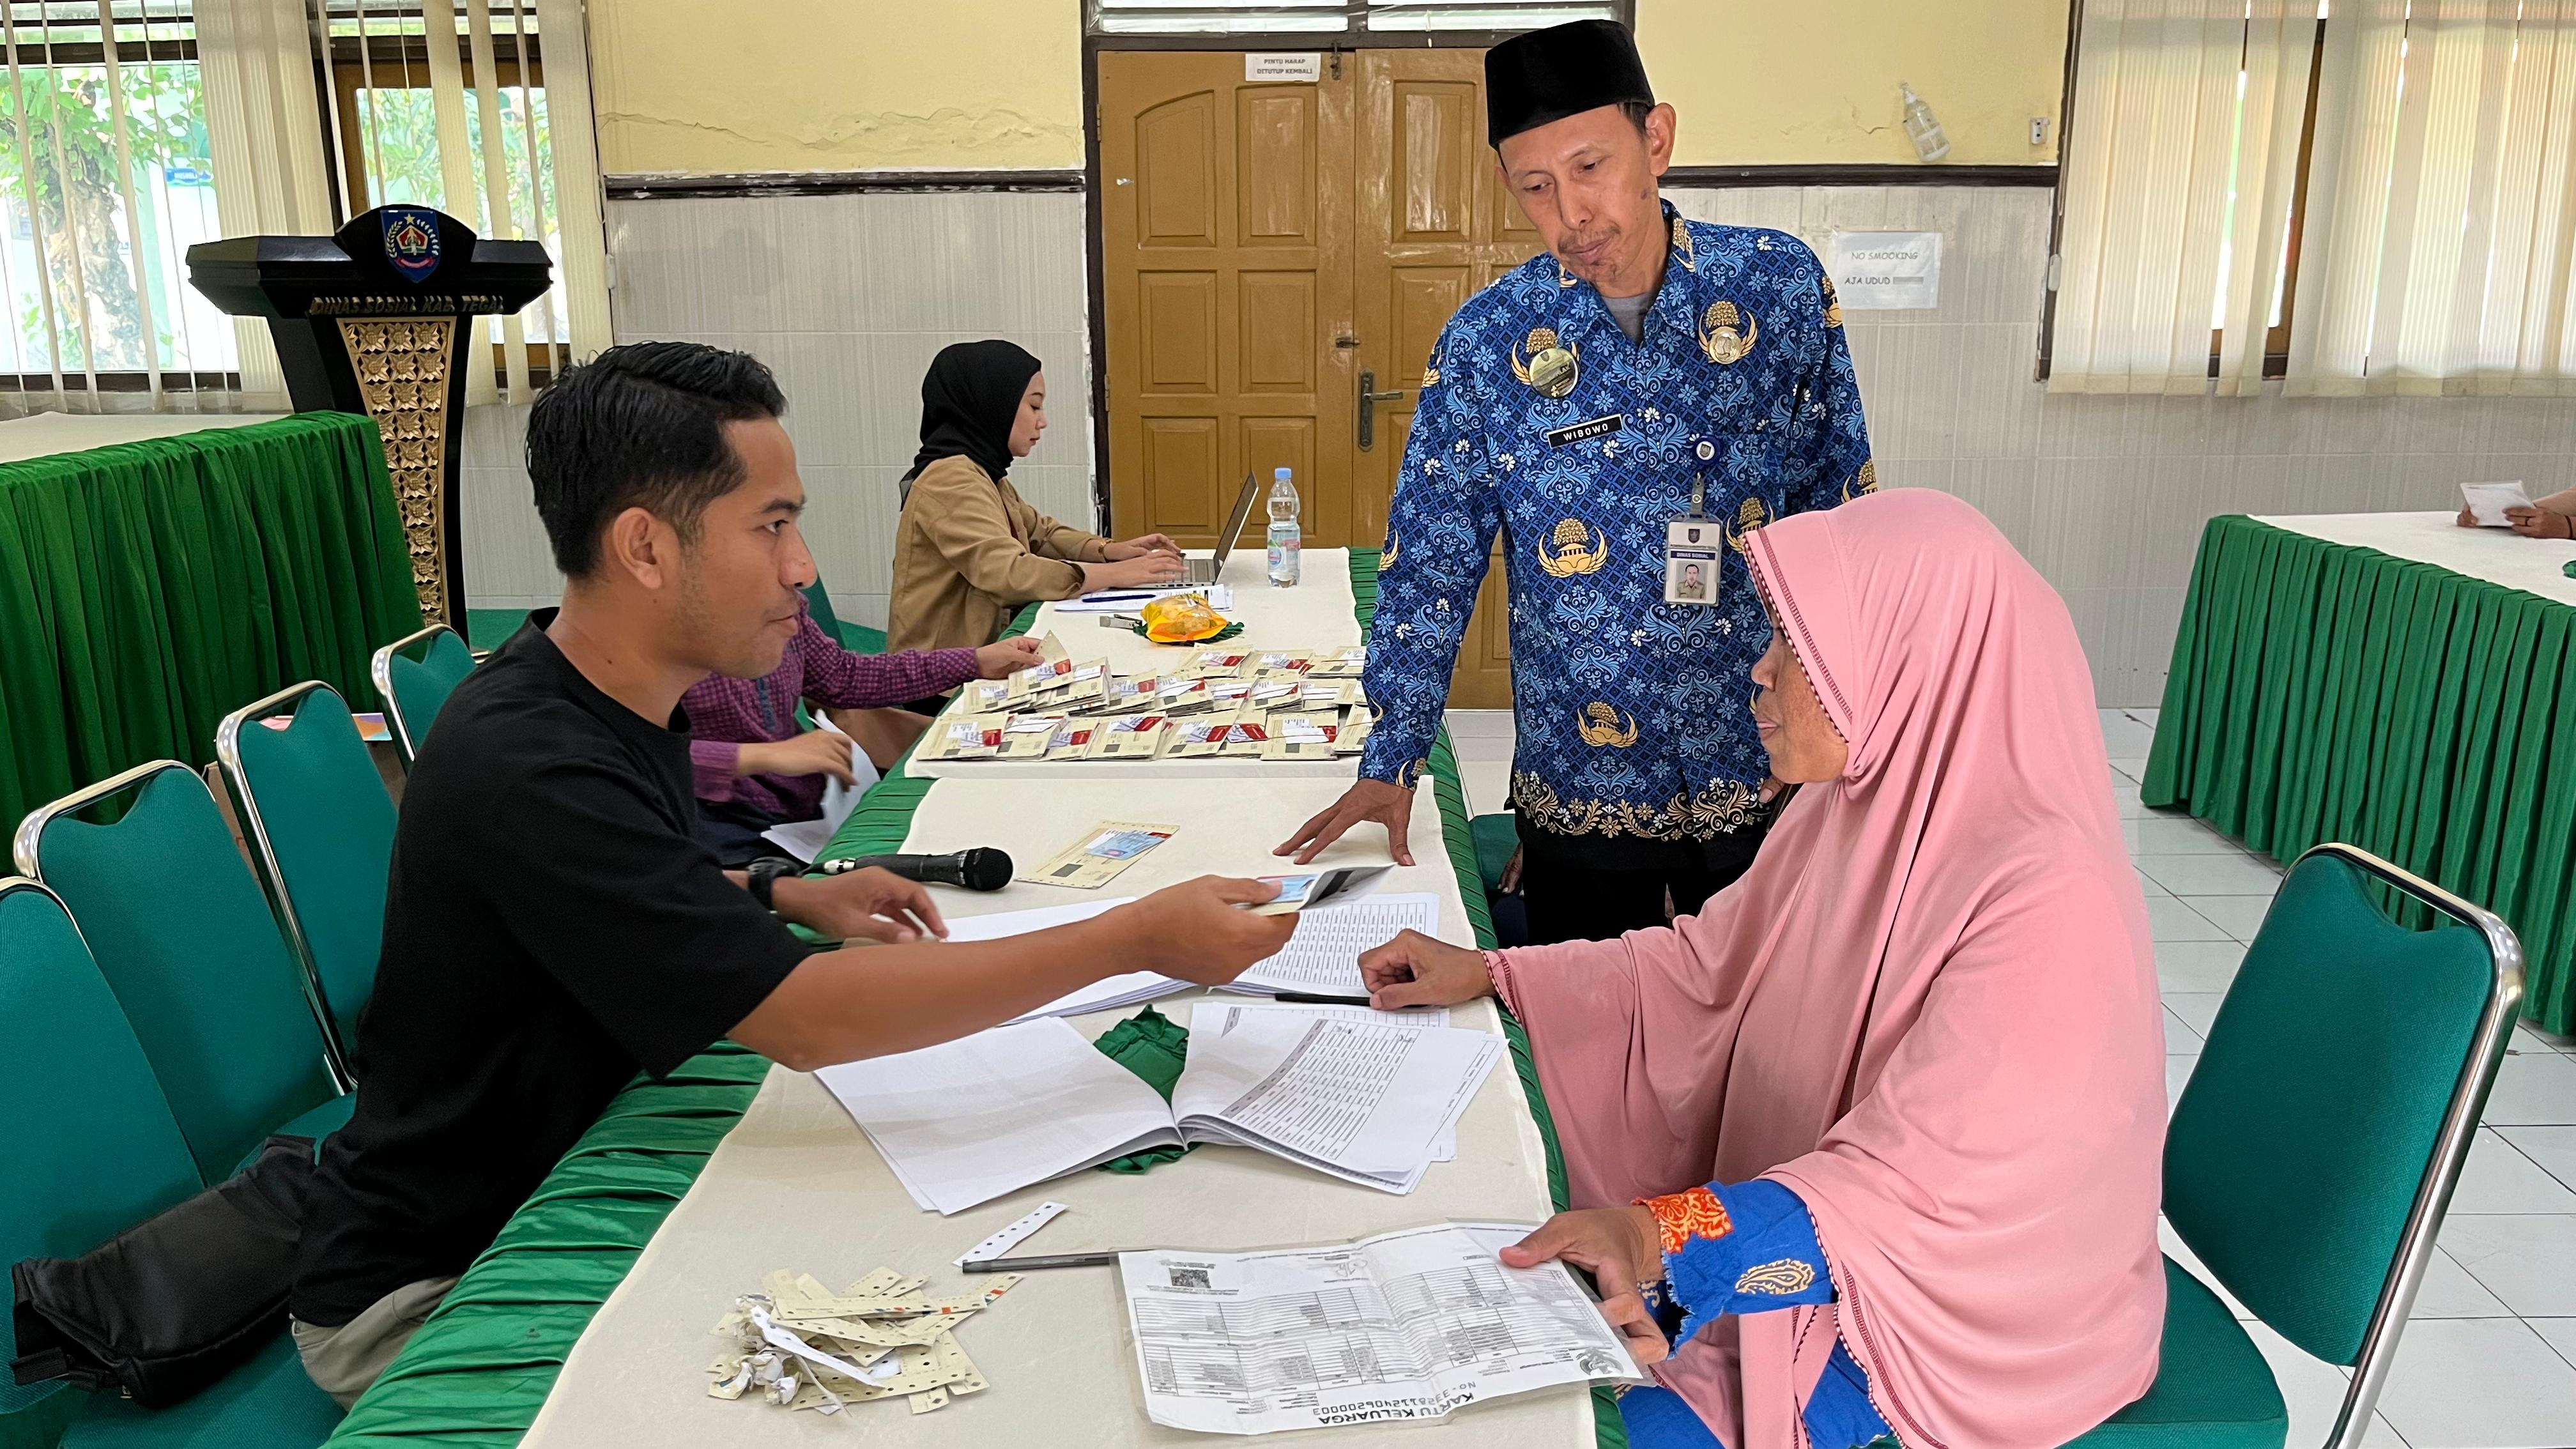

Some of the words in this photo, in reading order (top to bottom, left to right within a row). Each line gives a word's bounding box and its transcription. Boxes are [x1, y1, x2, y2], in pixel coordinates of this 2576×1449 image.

[1844, 277, 1863, 285] AJA
[1866, 277, 1890, 285] UDUD
[309, 296, 360, 315] DINAS
[362, 296, 417, 313] SOSIAL
[461, 295, 503, 312] TEGAL
[1563, 423, 1608, 441] WIBOWO
[1420, 1392, 1475, 1416] KARTU
[1318, 1407, 1414, 1425] KELUARGA
